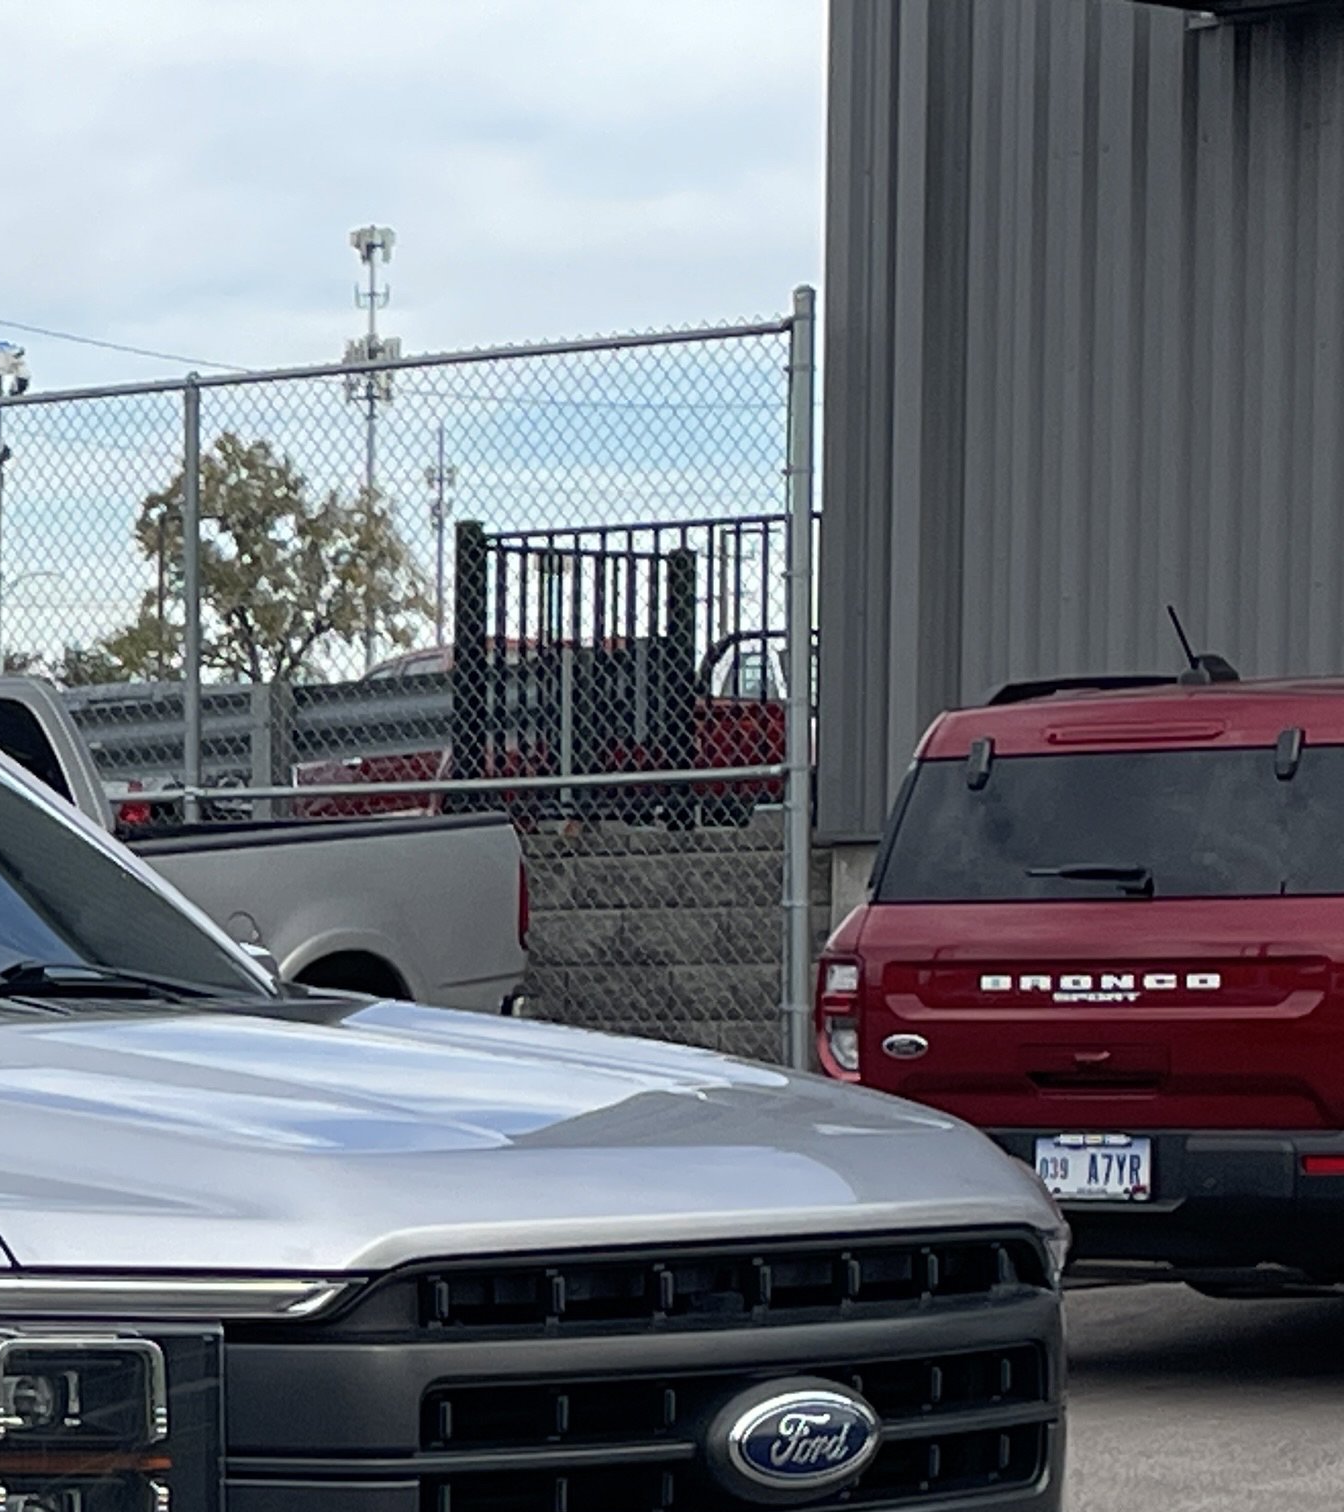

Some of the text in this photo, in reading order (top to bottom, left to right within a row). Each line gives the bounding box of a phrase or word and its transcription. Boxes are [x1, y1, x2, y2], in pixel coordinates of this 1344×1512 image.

[980, 974, 1221, 990] BRONCO
[1088, 1153, 1141, 1186] A7YR
[770, 1412, 851, 1466] Ford
